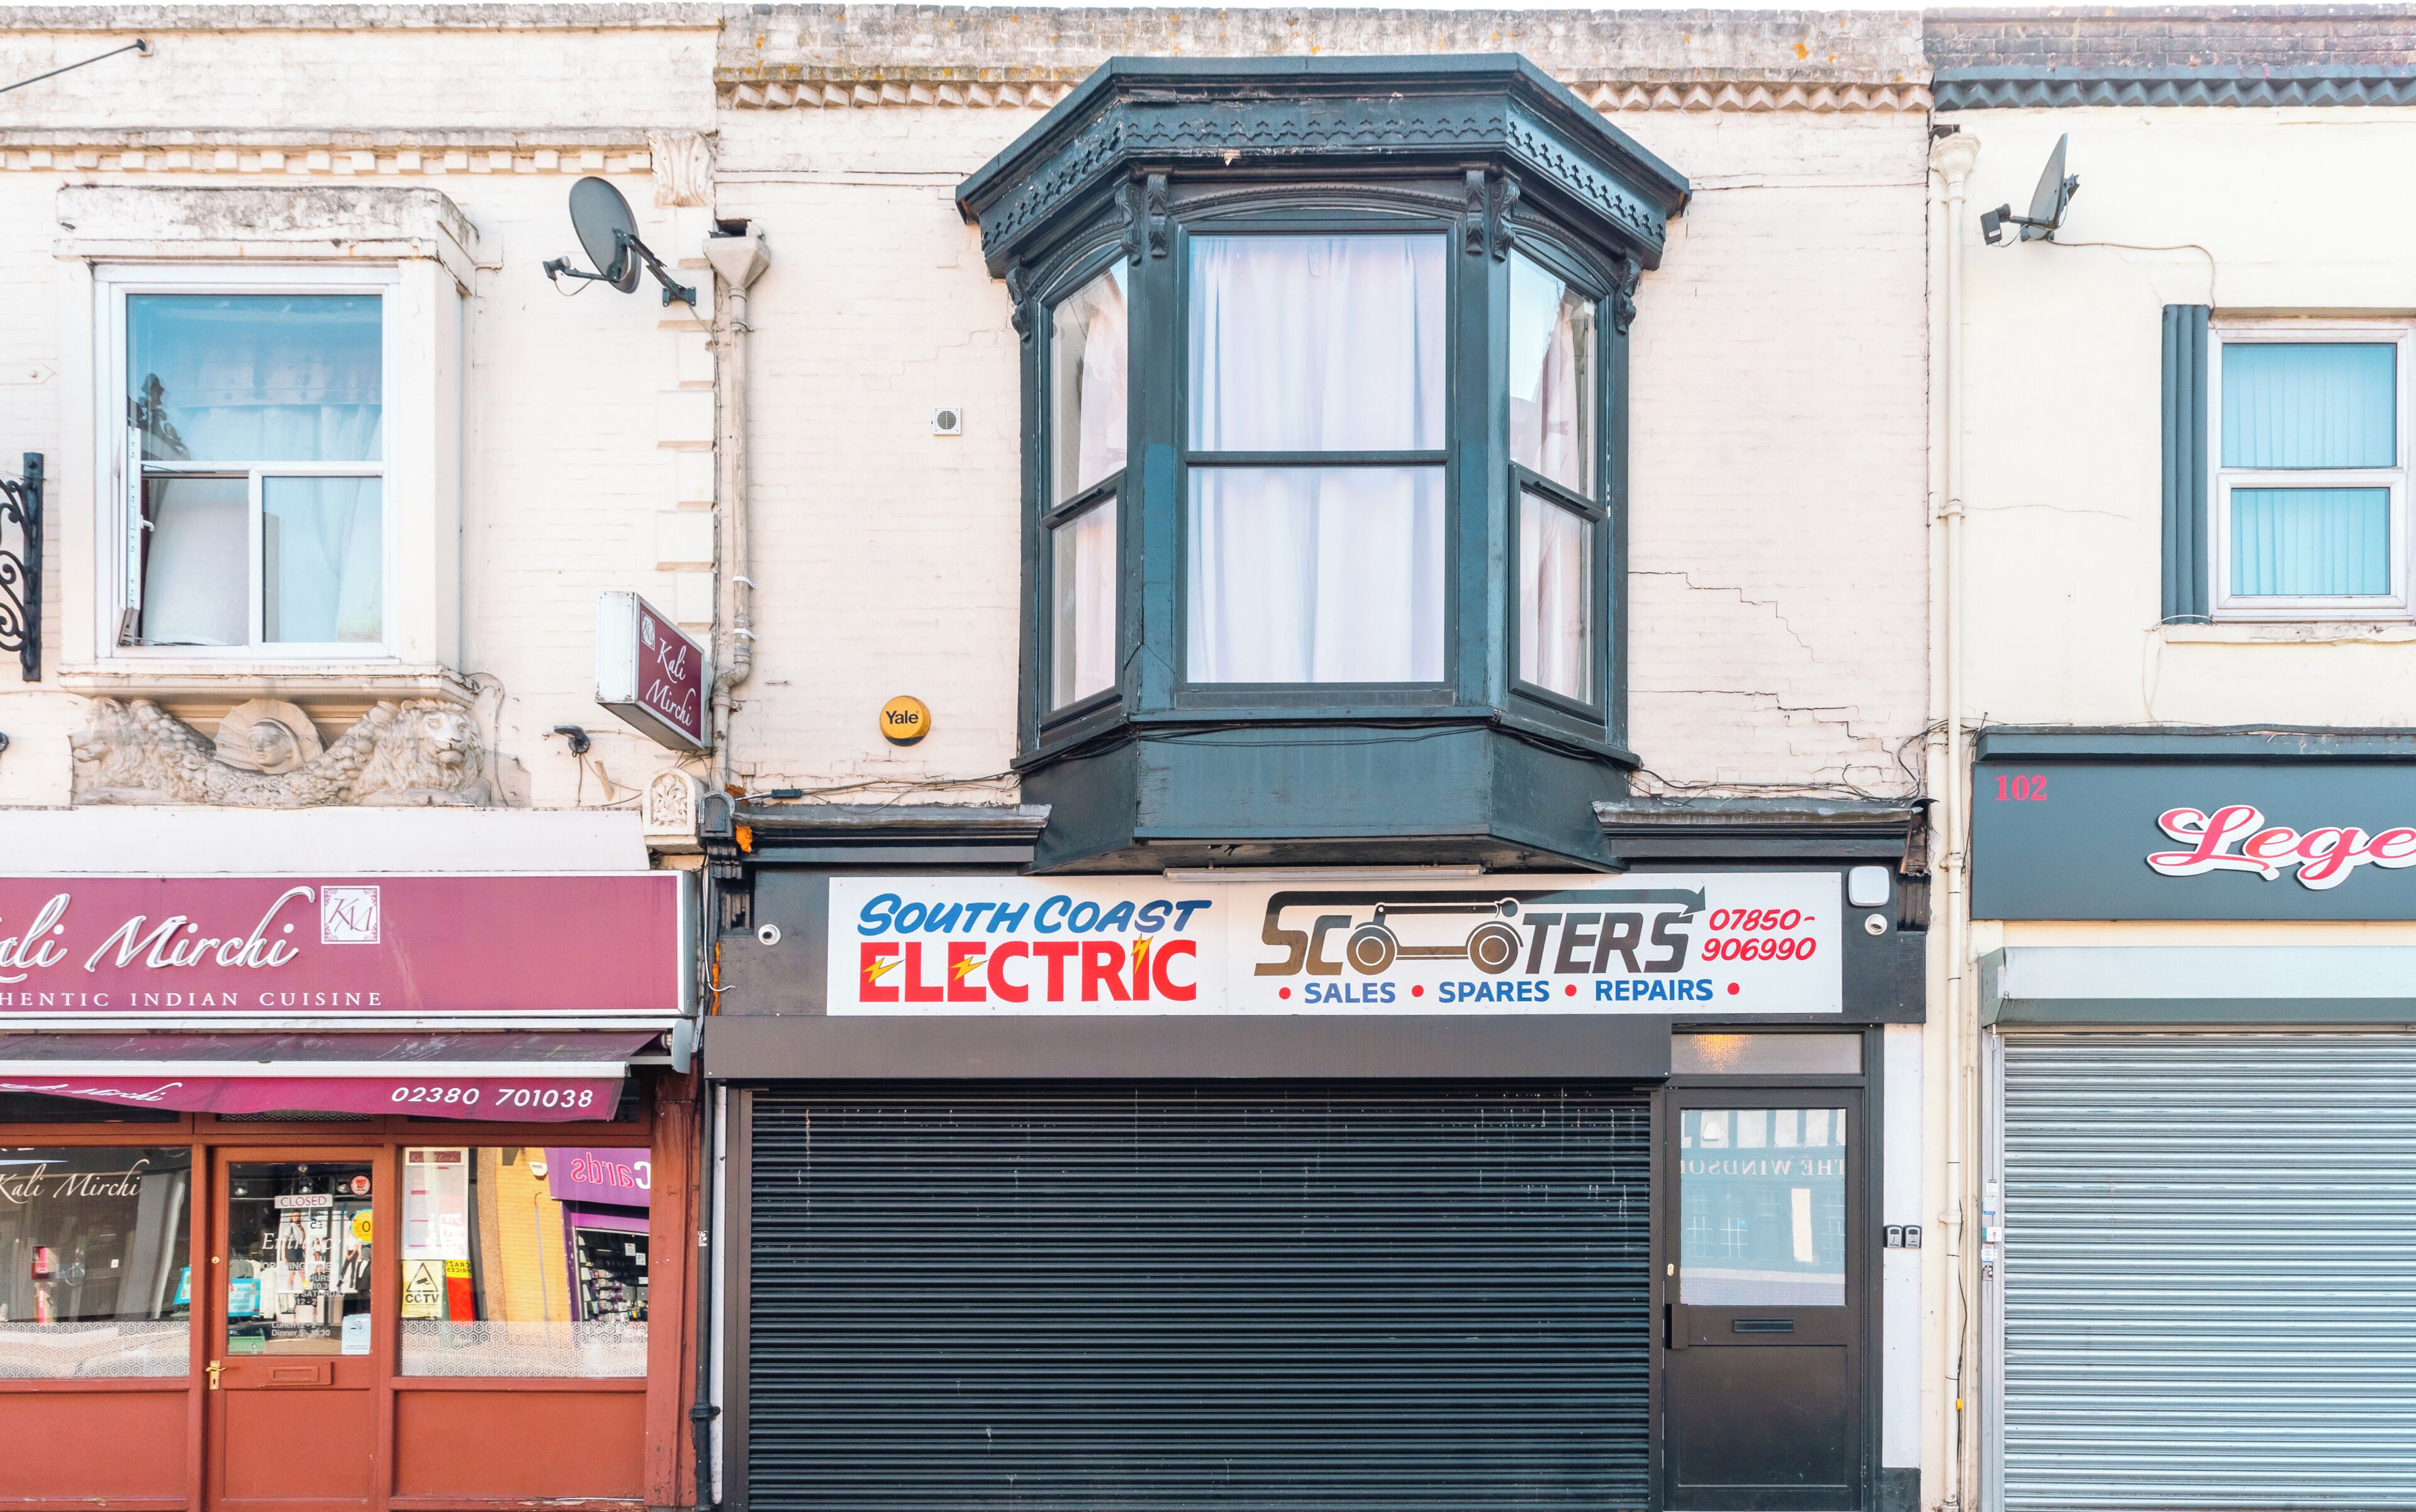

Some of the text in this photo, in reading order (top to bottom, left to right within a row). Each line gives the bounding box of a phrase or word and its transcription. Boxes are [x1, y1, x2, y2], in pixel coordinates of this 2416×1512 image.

[657, 637, 686, 684] Kali
[646, 679, 696, 726] Mirchi
[885, 710, 919, 724] Yale
[1994, 775, 2047, 801] 102
[2145, 804, 2416, 890] Lege
[857, 893, 1212, 936] SOUTH COAST
[0, 886, 315, 983] ali Mirchi
[1701, 937, 1816, 961] 906990
[859, 939, 1197, 1003] ELECTRIC
[131, 992, 238, 1006] INDIAN
[259, 992, 382, 1007] CUISINE
[1304, 979, 1714, 1004] SALES SPARES REPAIRS
[391, 1087, 593, 1108] 02380 701038
[53, 1158, 150, 1198] Mirchi
[281, 1196, 327, 1207] CLOSED
[405, 1294, 439, 1303] CCTV
